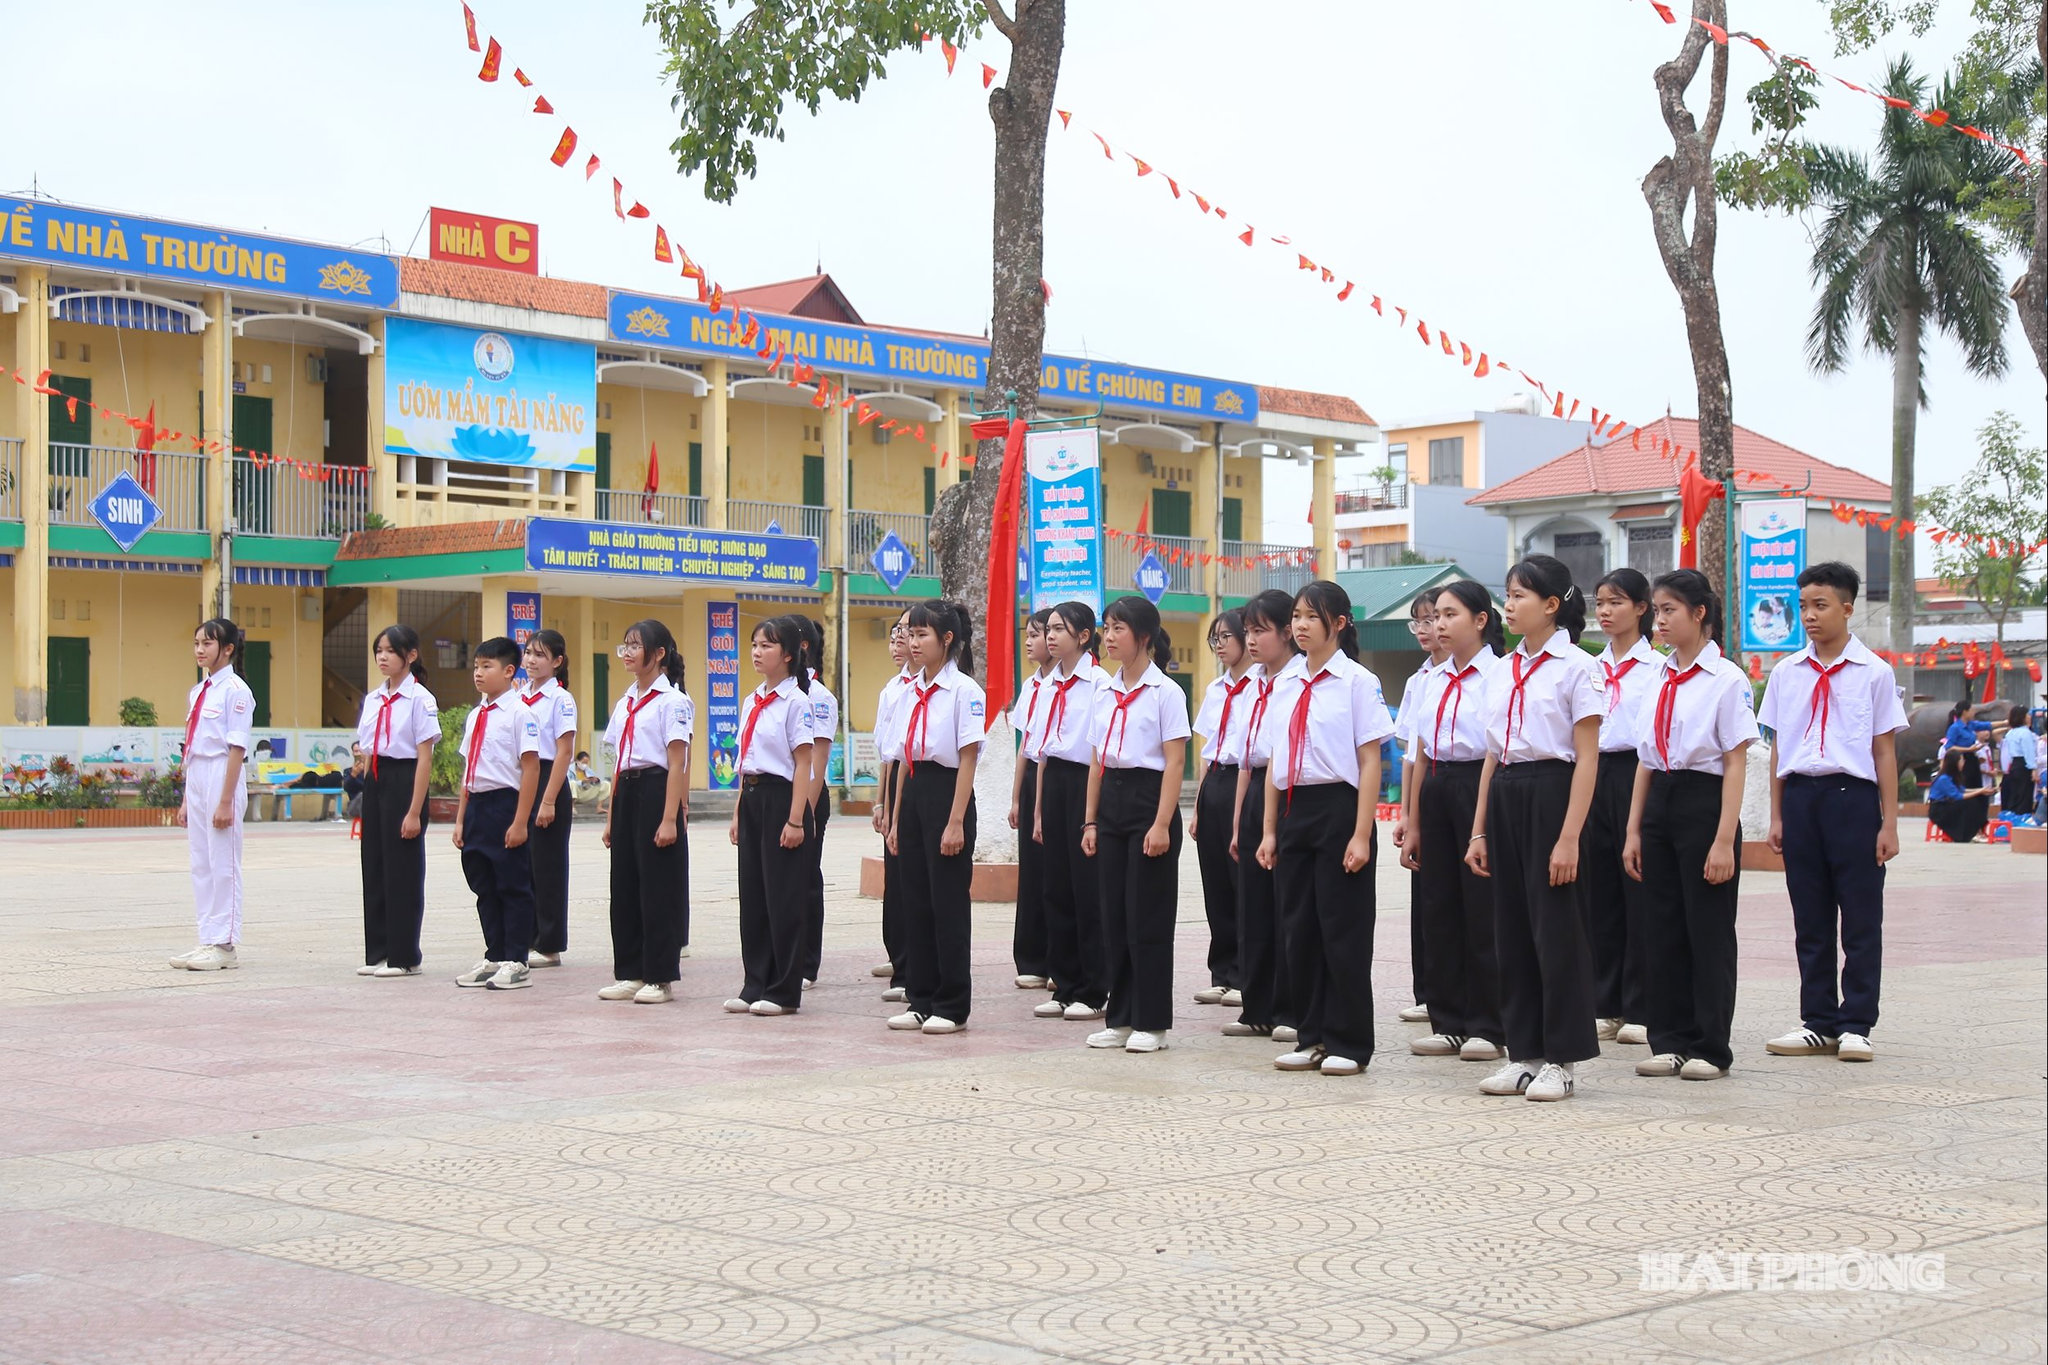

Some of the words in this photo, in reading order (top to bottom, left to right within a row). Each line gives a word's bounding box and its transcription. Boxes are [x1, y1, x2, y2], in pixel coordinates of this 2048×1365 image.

[47, 219, 129, 261] NHÀ
[141, 234, 286, 284] TRƯỜNG
[439, 221, 486, 259] NHÀ
[495, 223, 530, 264] C
[769, 328, 817, 359] MAI
[825, 334, 875, 367] NHÀ
[886, 343, 977, 379] TRƯỜNG
[1065, 363, 1091, 393] VỀ
[1097, 371, 1165, 403] CHÚNG
[1172, 383, 1201, 409] EM
[398, 381, 442, 421] ƯƠM
[447, 377, 490, 426] MẦM
[496, 388, 528, 429] TÀI
[533, 392, 584, 435] NĂNG
[107, 496, 143, 525] SINH
[589, 529, 610, 547] NHÀ
[612, 530, 635, 548] GIÁO
[638, 533, 675, 551] TRƯỜNG
[677, 533, 698, 553] TIỂU
[700, 538, 719, 557] HỌC
[748, 543, 767, 560] ĐẠO
[543, 547, 565, 565] TÂM
[568, 548, 599, 568] HUYẾT
[608, 552, 639, 570] TRÁCH
[642, 555, 673, 575] NHIỆM
[682, 558, 719, 575] CHUYÊN
[721, 560, 754, 580] NGHIỆP
[762, 562, 787, 580] SÁNG
[788, 566, 806, 583] TẠO
[883, 547, 903, 576] MỘT
[512, 598, 536, 620] TRẺ
[711, 607, 735, 628] THẾ
[711, 633, 735, 651] GIỚI
[707, 656, 738, 675] NGÀY
[712, 682, 734, 698] MAI
